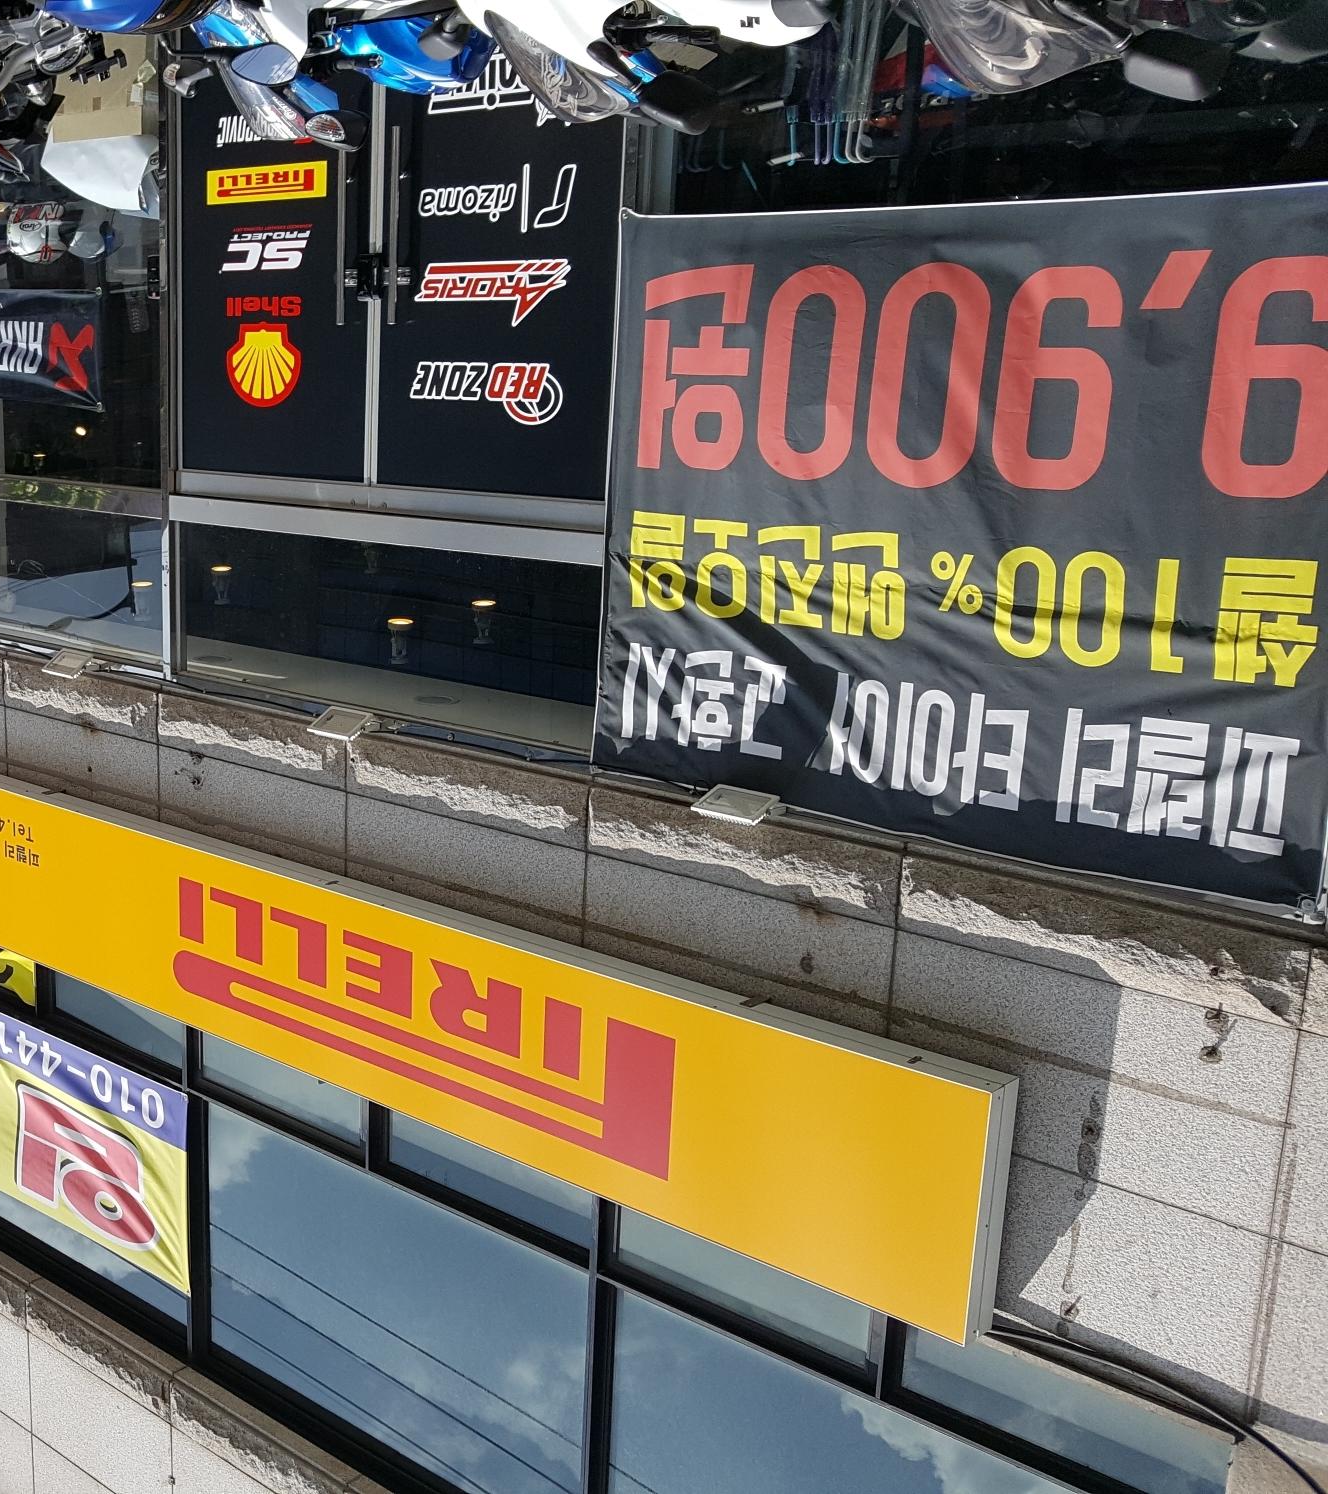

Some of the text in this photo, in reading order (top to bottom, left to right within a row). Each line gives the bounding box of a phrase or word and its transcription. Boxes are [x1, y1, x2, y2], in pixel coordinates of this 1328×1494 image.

[216, 168, 315, 199] PIRELLI
[418, 183, 517, 222] rizoma
[228, 230, 311, 242] PROJECT
[221, 240, 308, 272] SC
[226, 295, 302, 317] Shell
[410, 361, 550, 402] RED ZONE
[637, 249, 1328, 498] 9,900원
[630, 510, 907, 641] 엔진오일
[621, 642, 1300, 856] 피렐리 타이어 교환시
[4, 841, 40, 867] 피렐리
[172, 876, 676, 1181] PIRELLI
